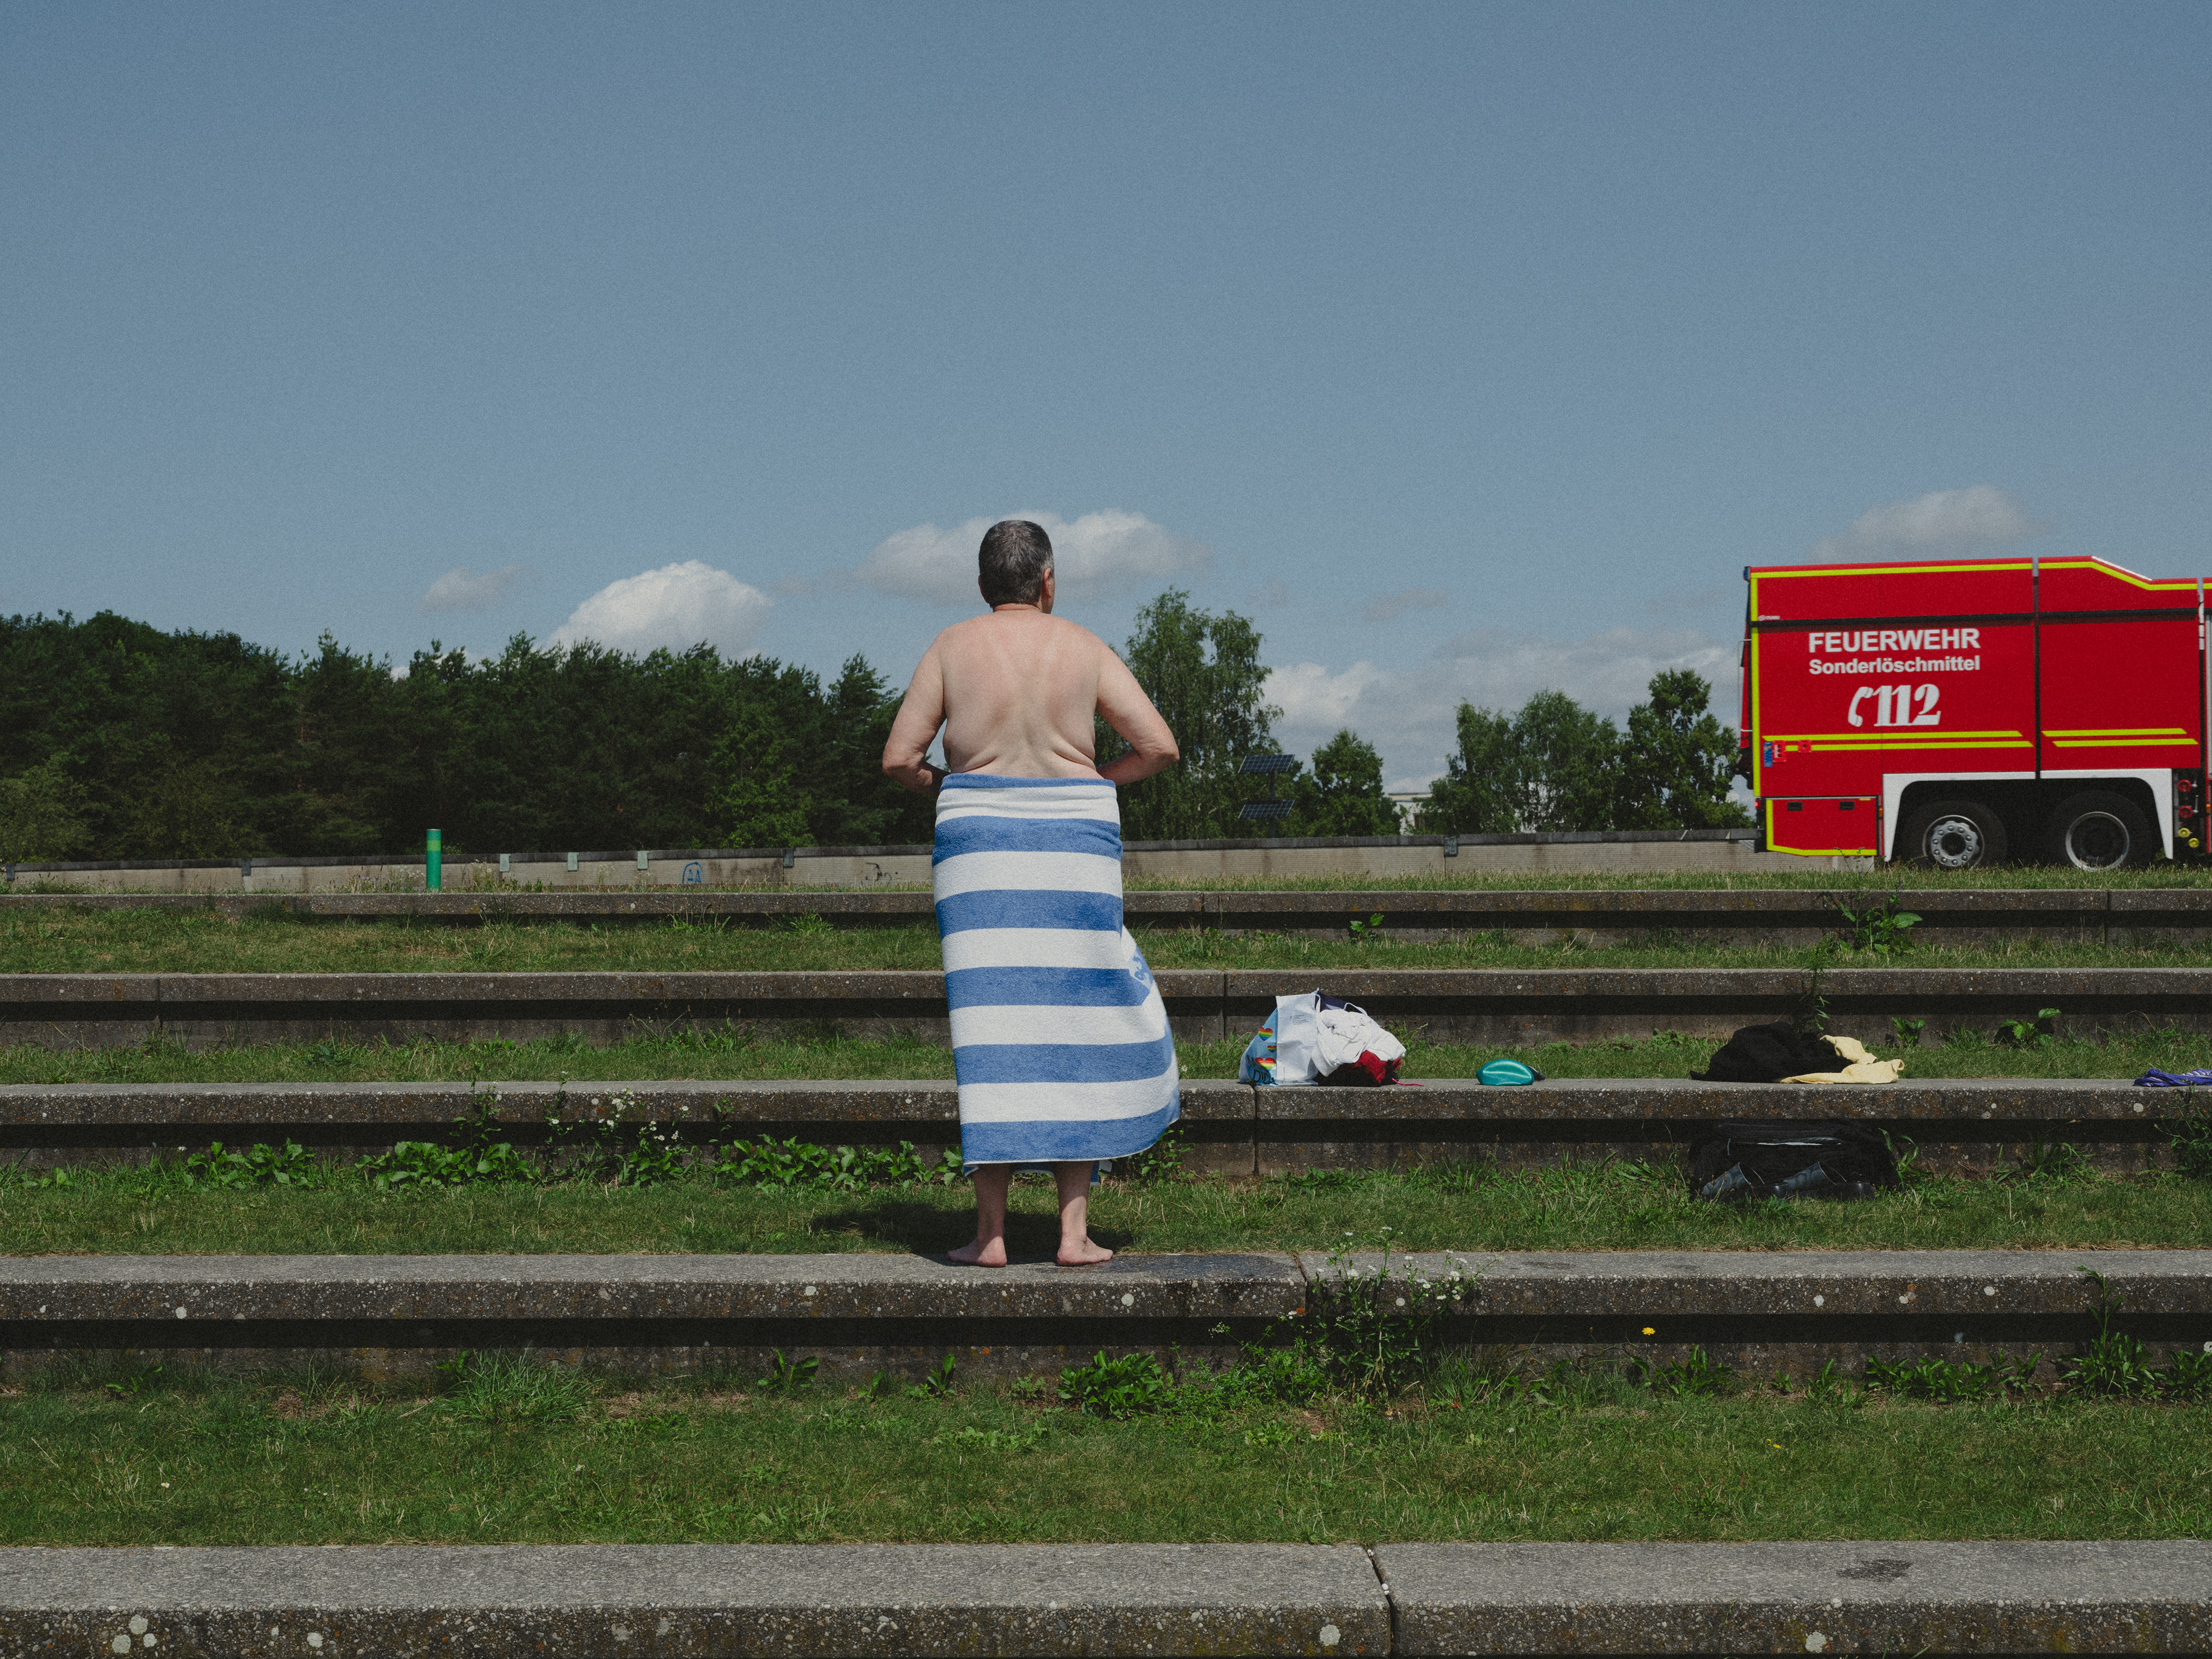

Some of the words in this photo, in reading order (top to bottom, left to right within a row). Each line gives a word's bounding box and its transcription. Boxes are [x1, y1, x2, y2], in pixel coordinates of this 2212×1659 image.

[1809, 628, 1980, 653] FEUERWEHR
[1809, 655, 1980, 675] Sonderlöschmittel
[1872, 684, 1941, 726] 112
